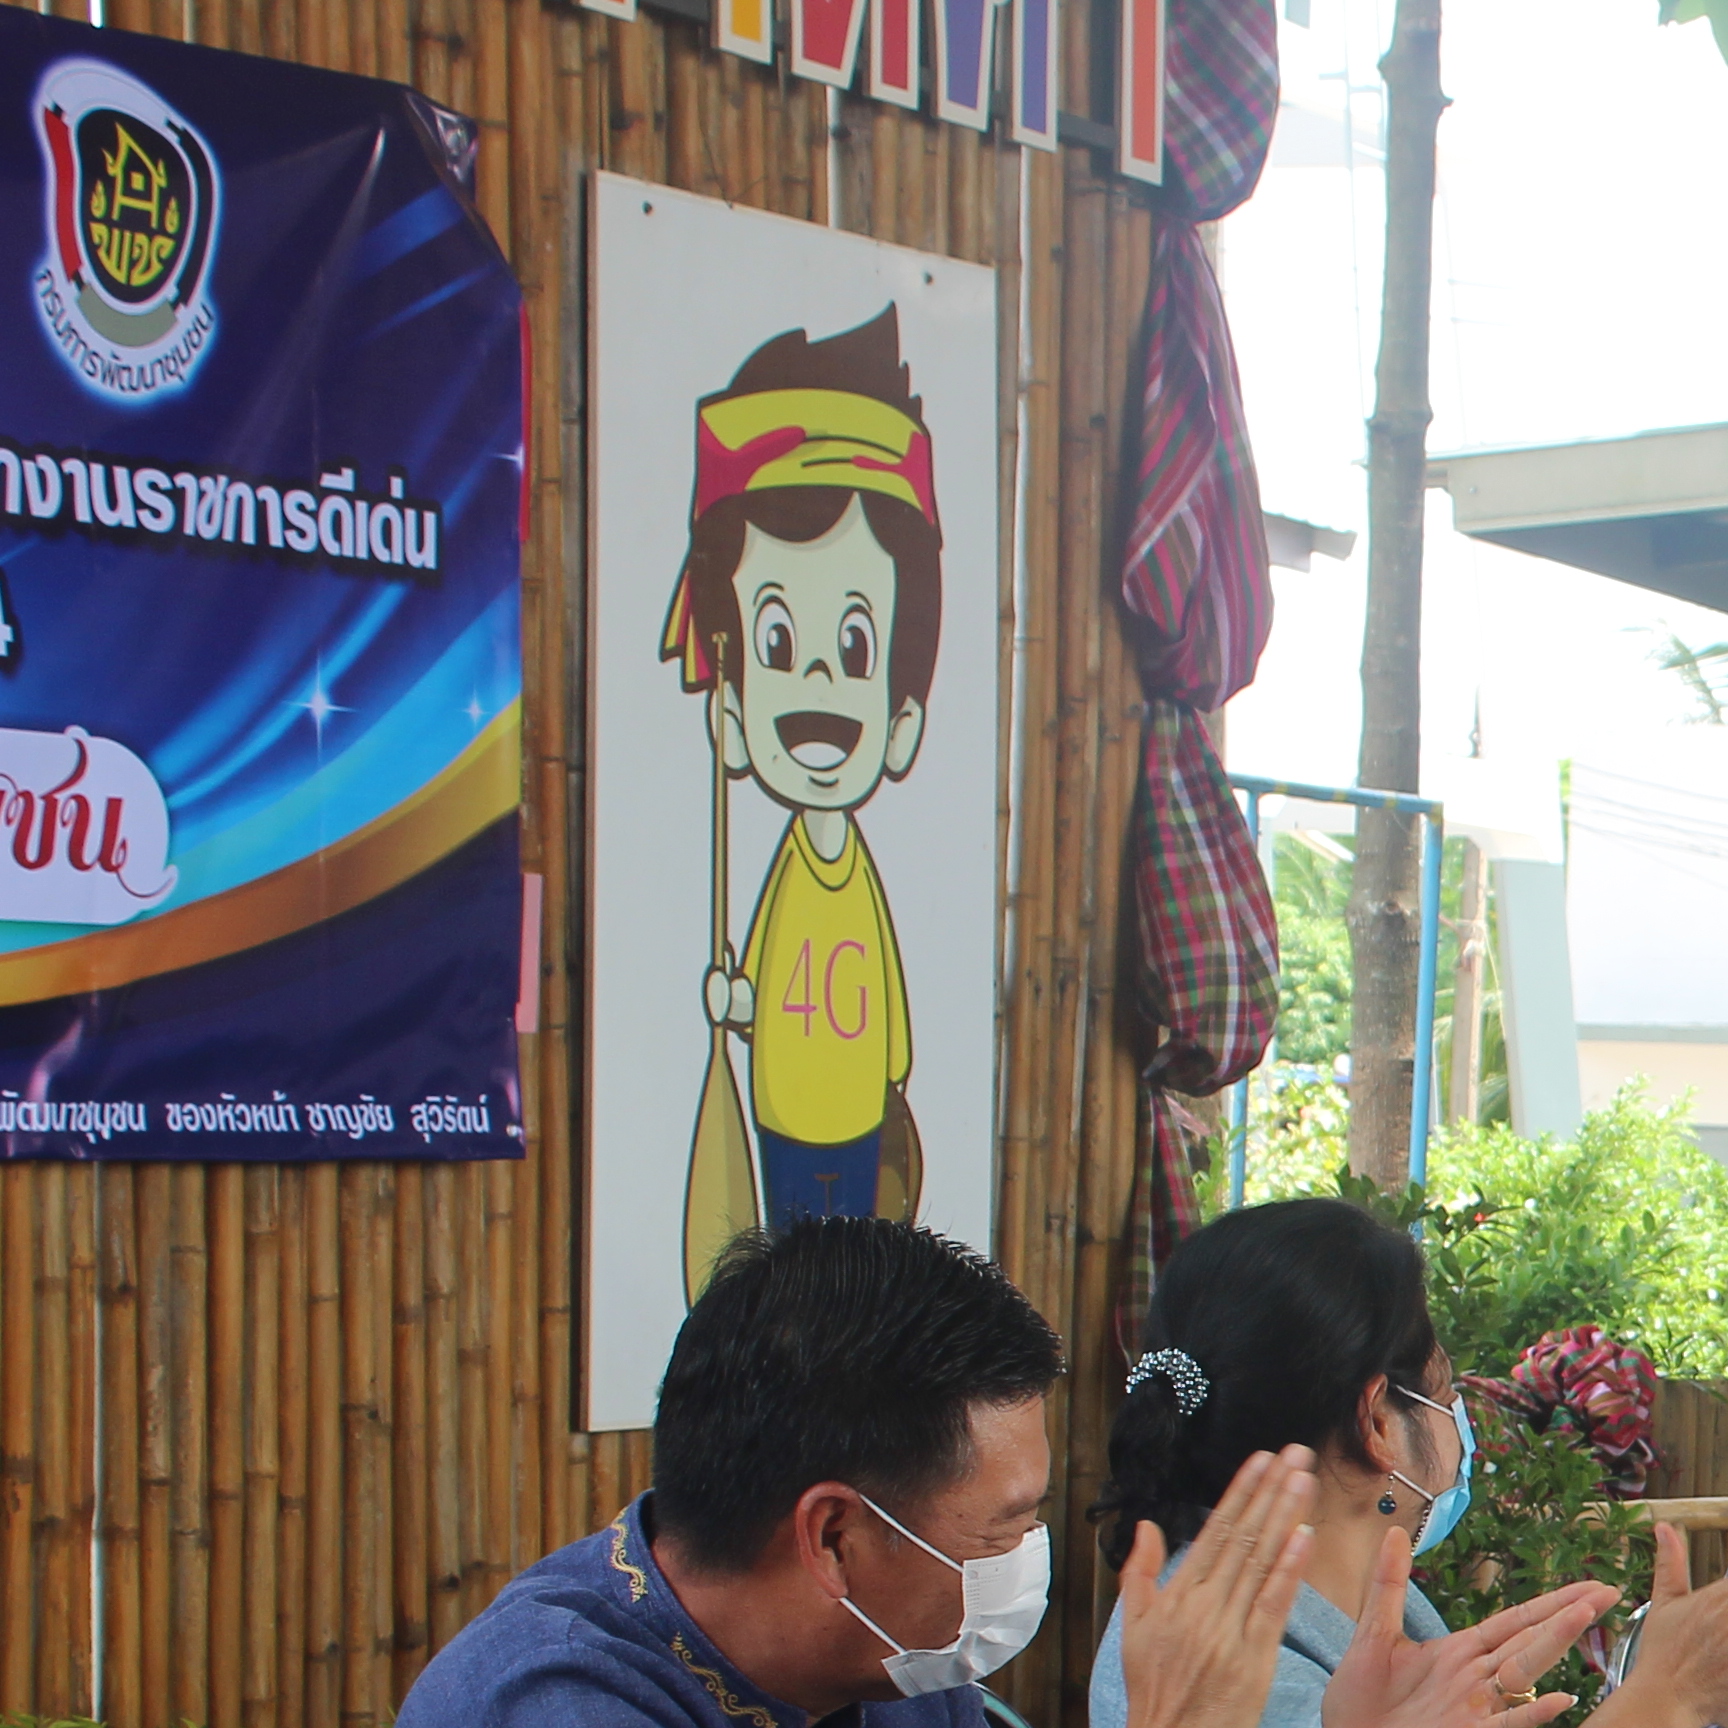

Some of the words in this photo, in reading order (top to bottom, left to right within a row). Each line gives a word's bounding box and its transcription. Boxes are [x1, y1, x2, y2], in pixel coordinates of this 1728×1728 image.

[0, 738, 175, 898] ชน
[780, 938, 868, 1040] 4G
[166, 1090, 300, 1134] ของหัวหน้า
[305, 1095, 395, 1140] ชาญชัย
[411, 1094, 490, 1144] สุวิรัตน์
